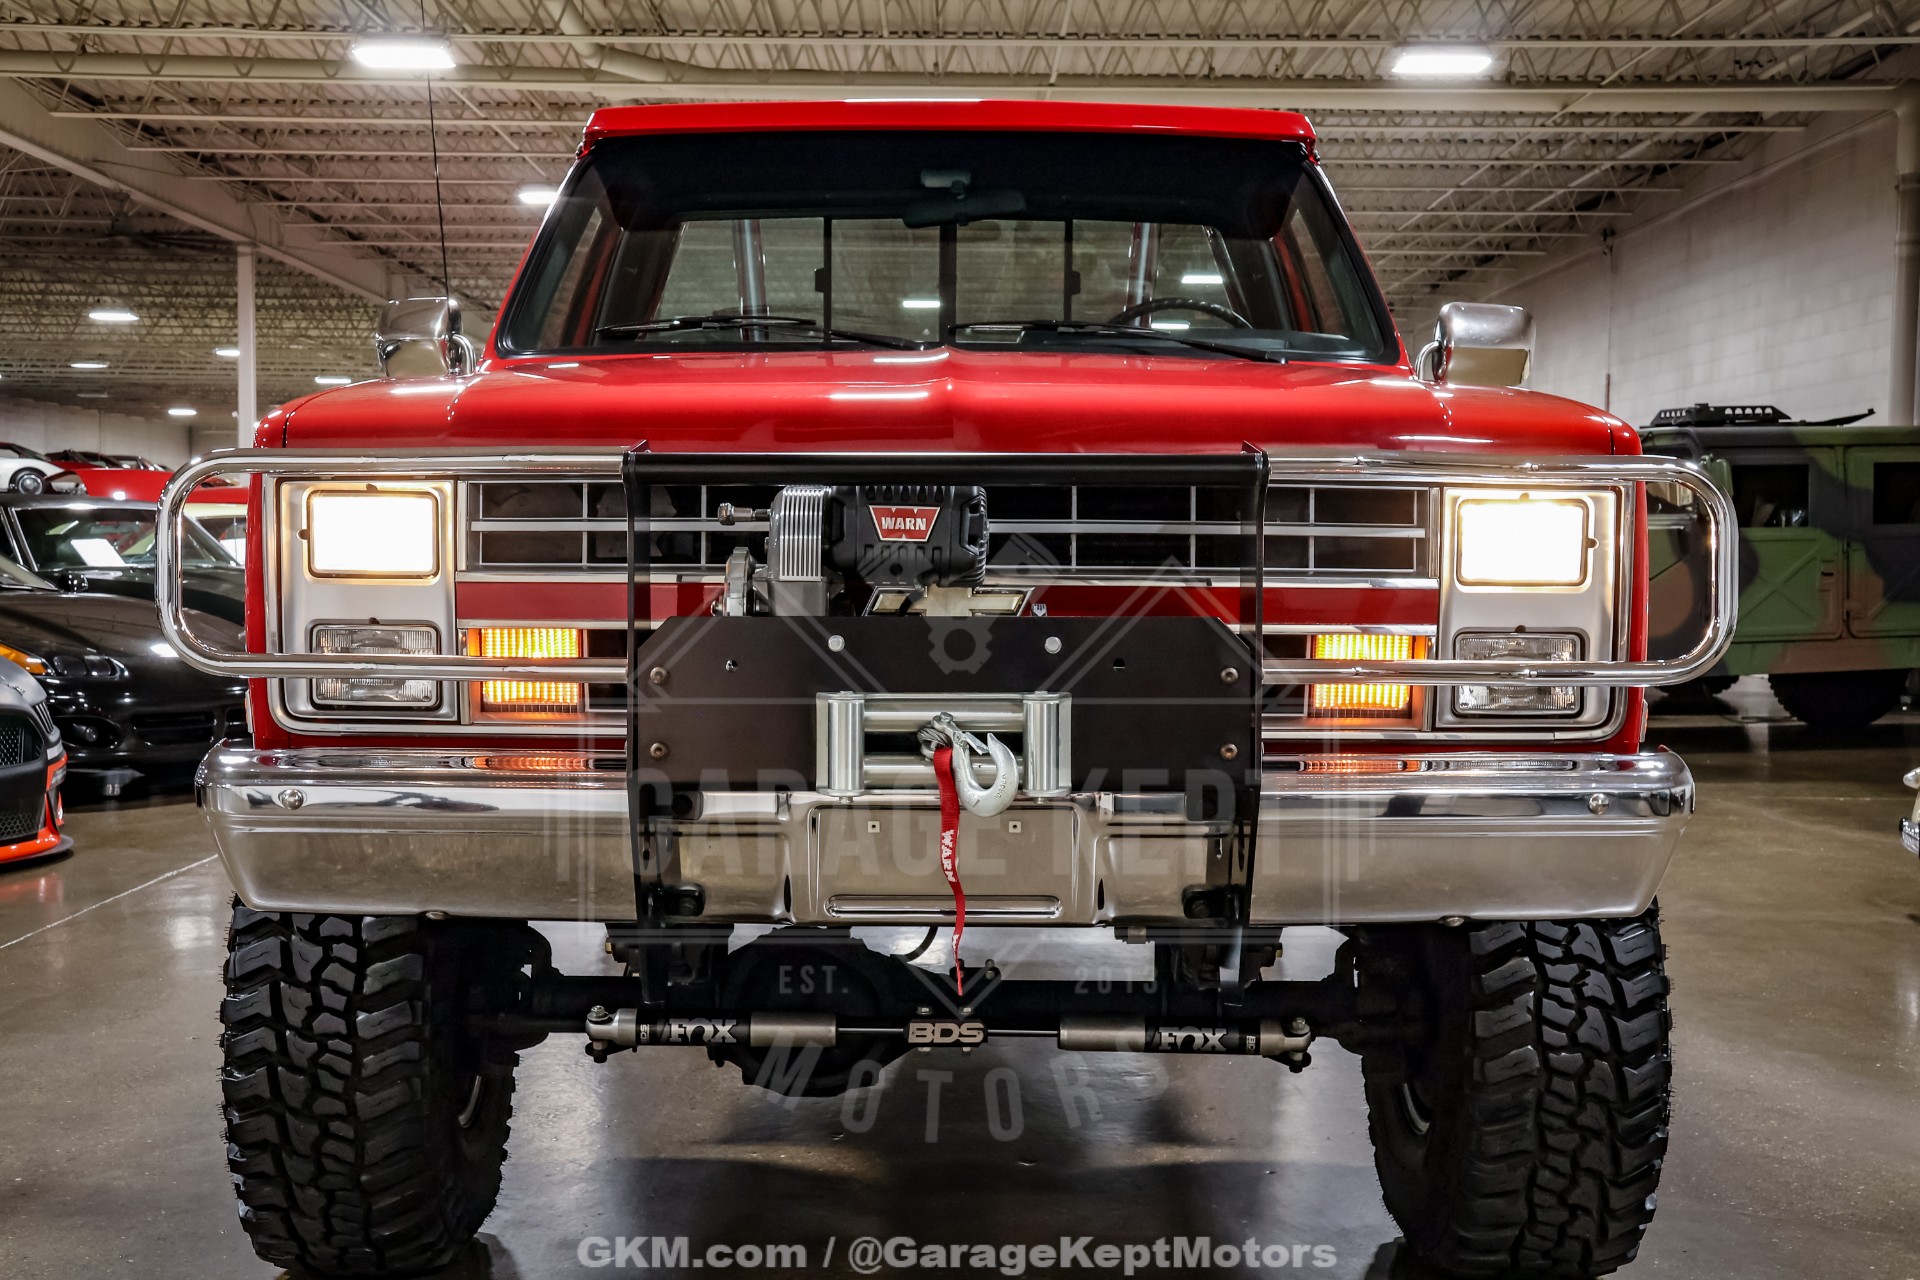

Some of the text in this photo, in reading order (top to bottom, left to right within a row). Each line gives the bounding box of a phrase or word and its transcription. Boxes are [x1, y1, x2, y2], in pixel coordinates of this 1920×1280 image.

[881, 516, 927, 531] WARN
[941, 829, 956, 882] WARN
[669, 1017, 737, 1044] FOX
[908, 1022, 985, 1044] BDS
[1158, 1026, 1227, 1053] FOX
